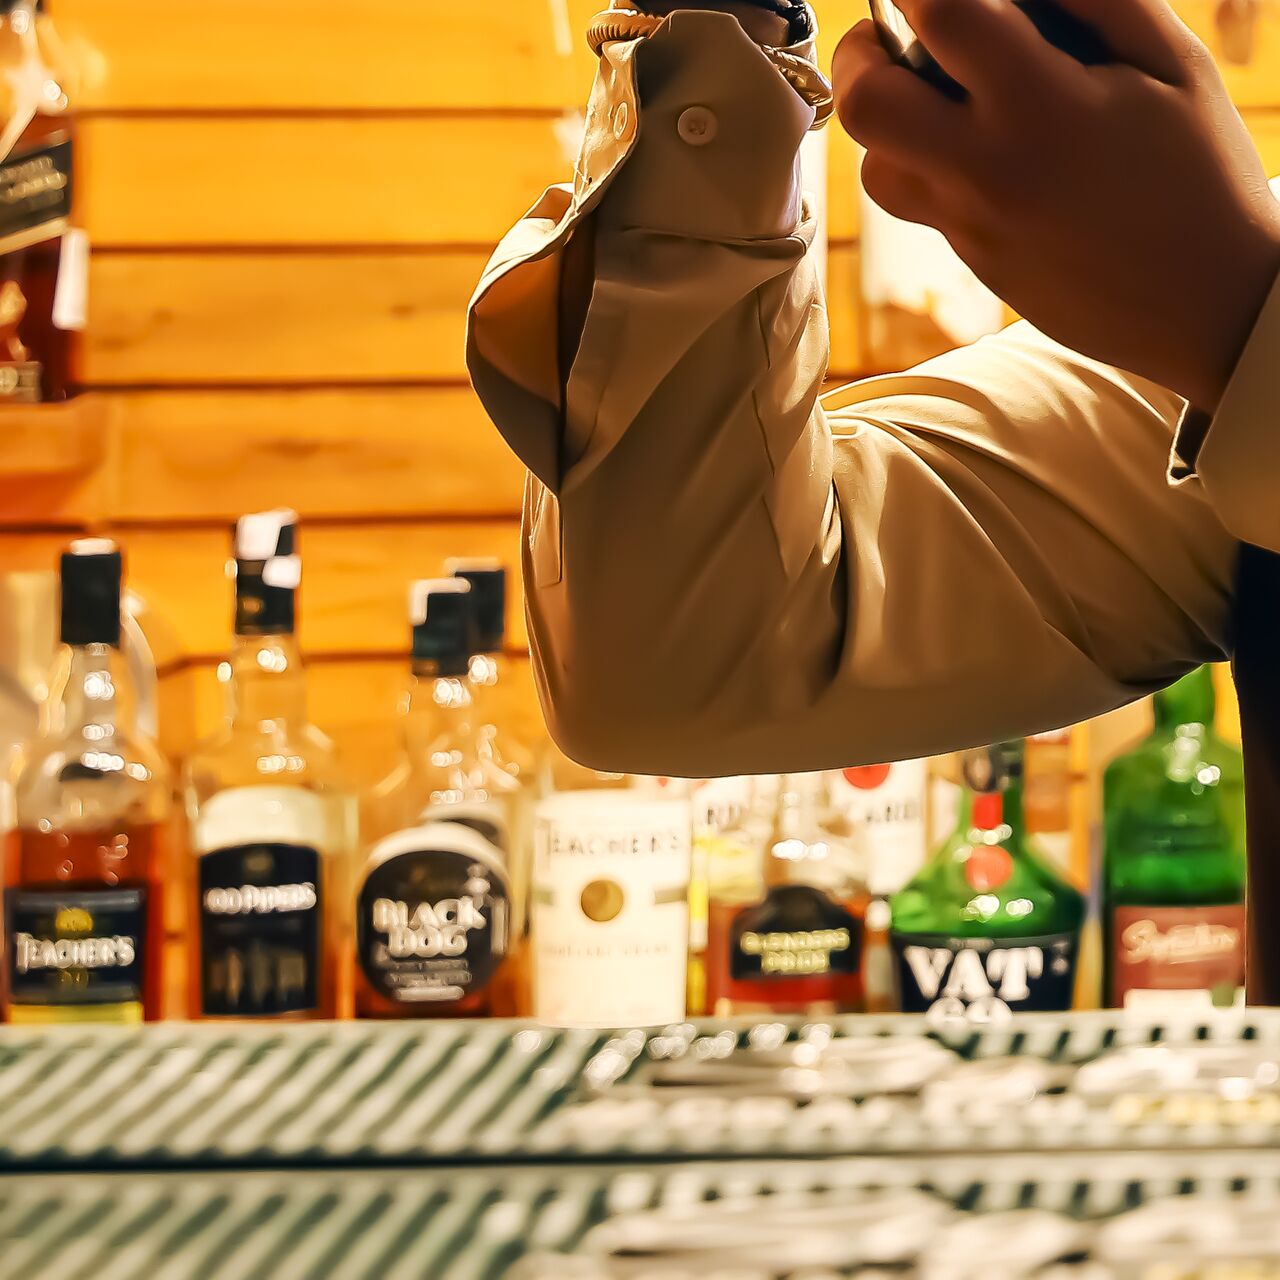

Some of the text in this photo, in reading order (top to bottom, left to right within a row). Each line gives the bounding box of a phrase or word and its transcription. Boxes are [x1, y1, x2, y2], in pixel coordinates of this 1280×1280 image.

[373, 896, 487, 933] BLACK
[388, 923, 469, 958] DOG
[903, 944, 1044, 1001] VAT
